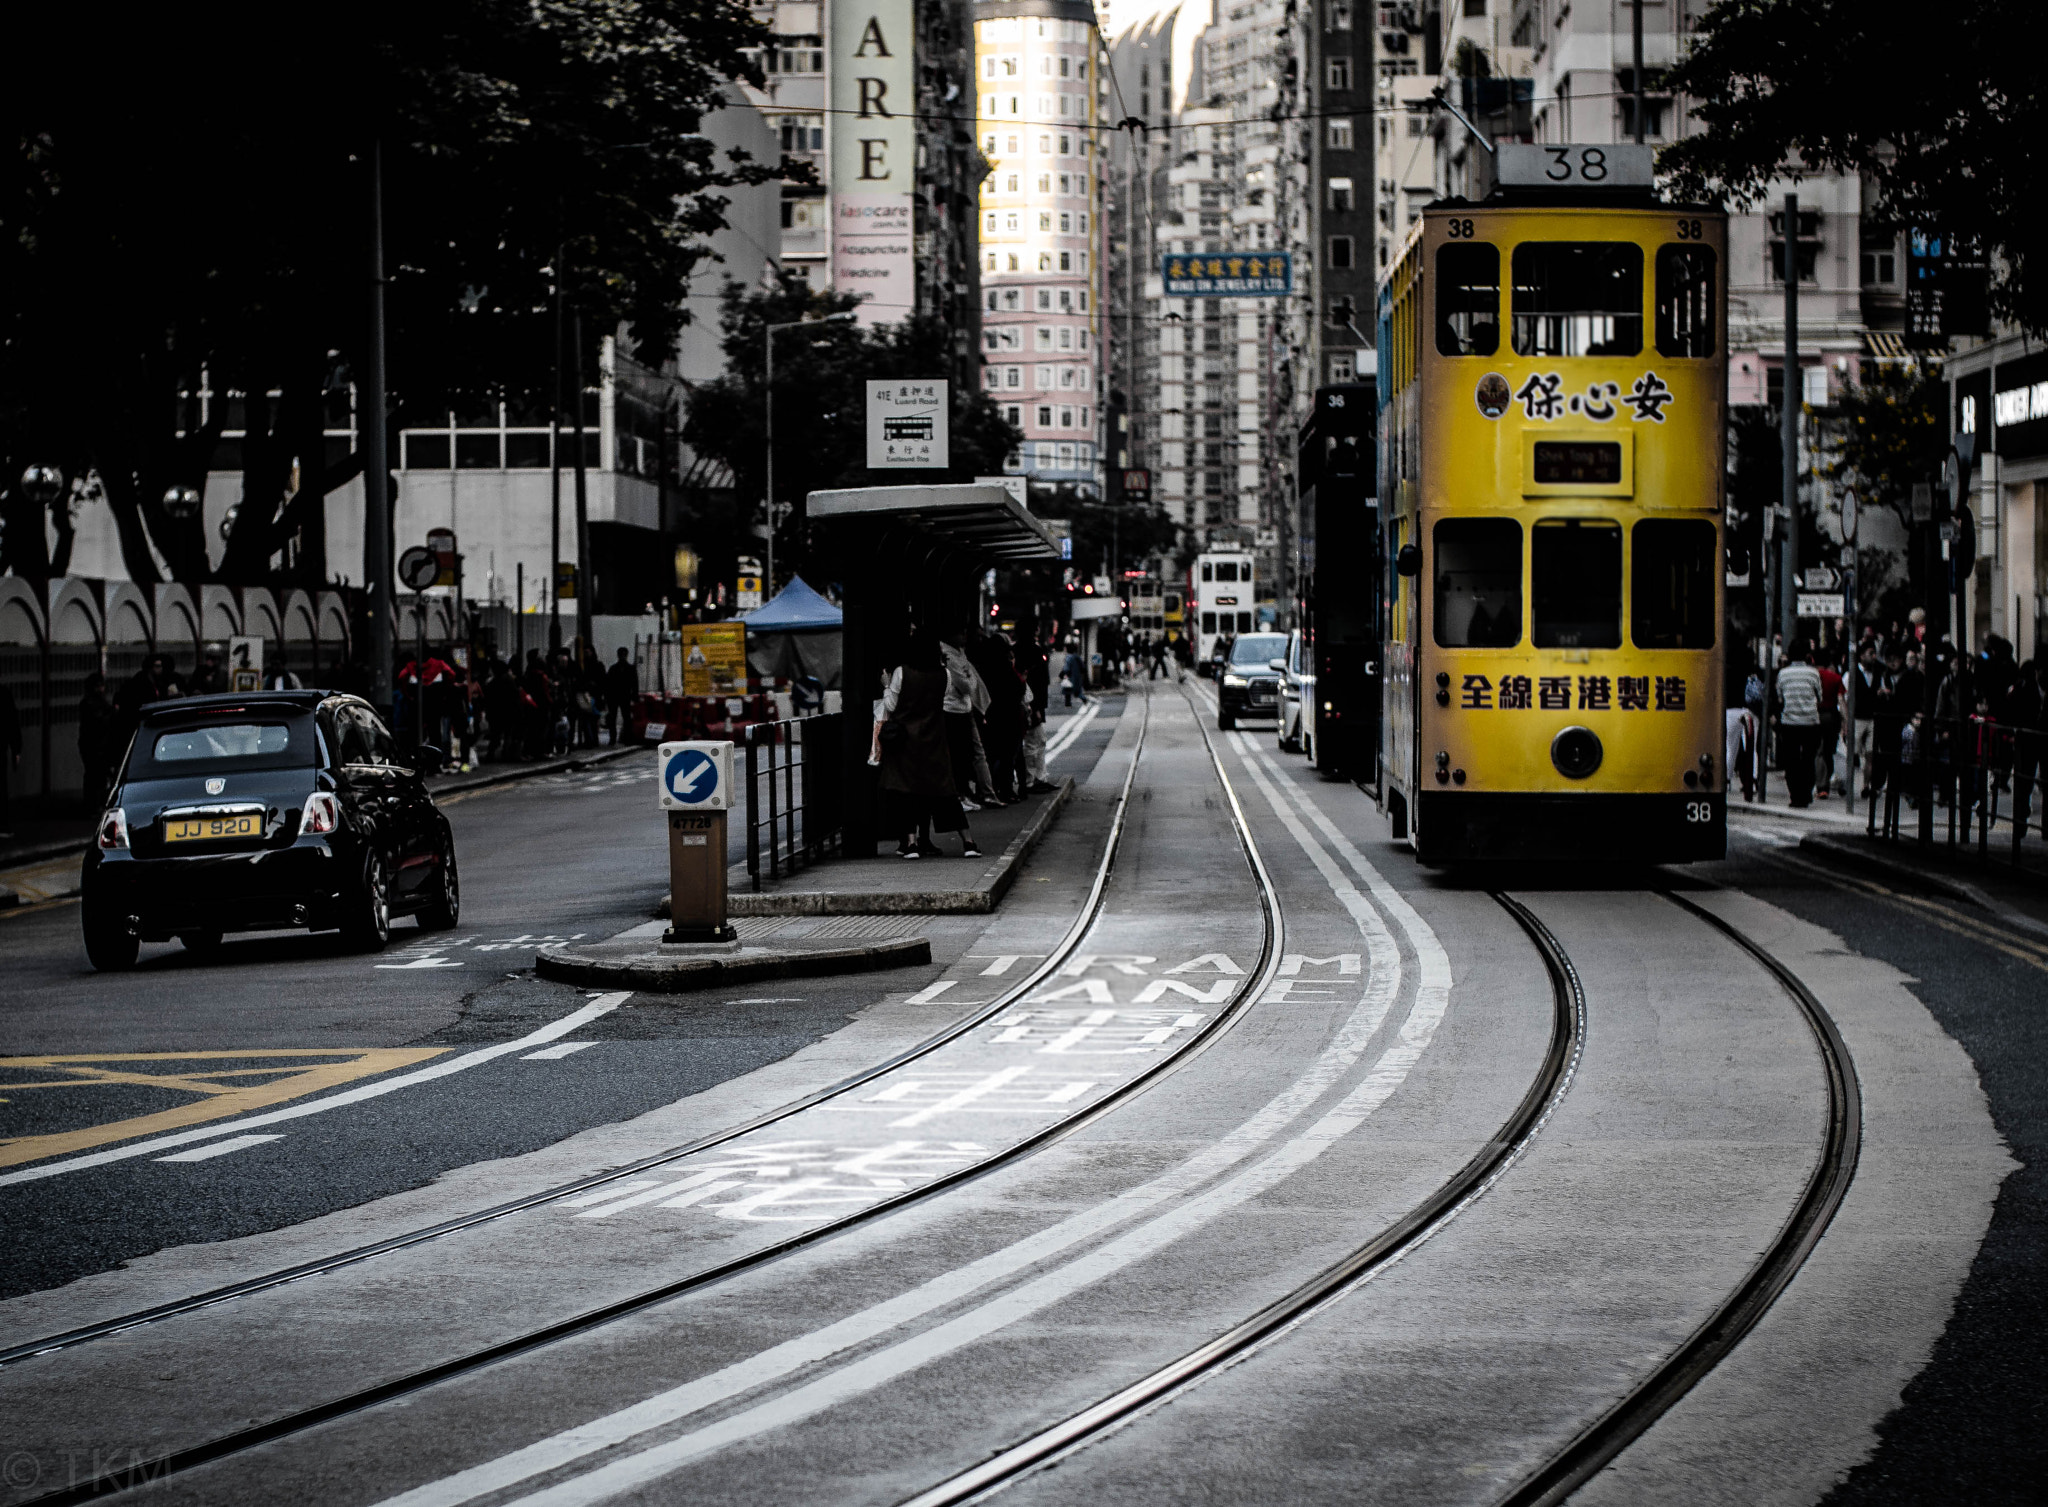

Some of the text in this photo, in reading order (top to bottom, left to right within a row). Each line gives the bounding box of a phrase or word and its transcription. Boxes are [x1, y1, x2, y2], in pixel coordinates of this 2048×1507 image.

[1544, 147, 1608, 181] 38
[1448, 218, 1475, 239] 38
[1677, 219, 1703, 240] 38
[1514, 371, 1674, 423] 保心安
[1461, 674, 1687, 711] 全線香港製造
[1687, 802, 1711, 822] 38
[175, 818, 251, 838] JJ 920
[966, 953, 1364, 976] TRAM
[902, 978, 1360, 1005] LANE
